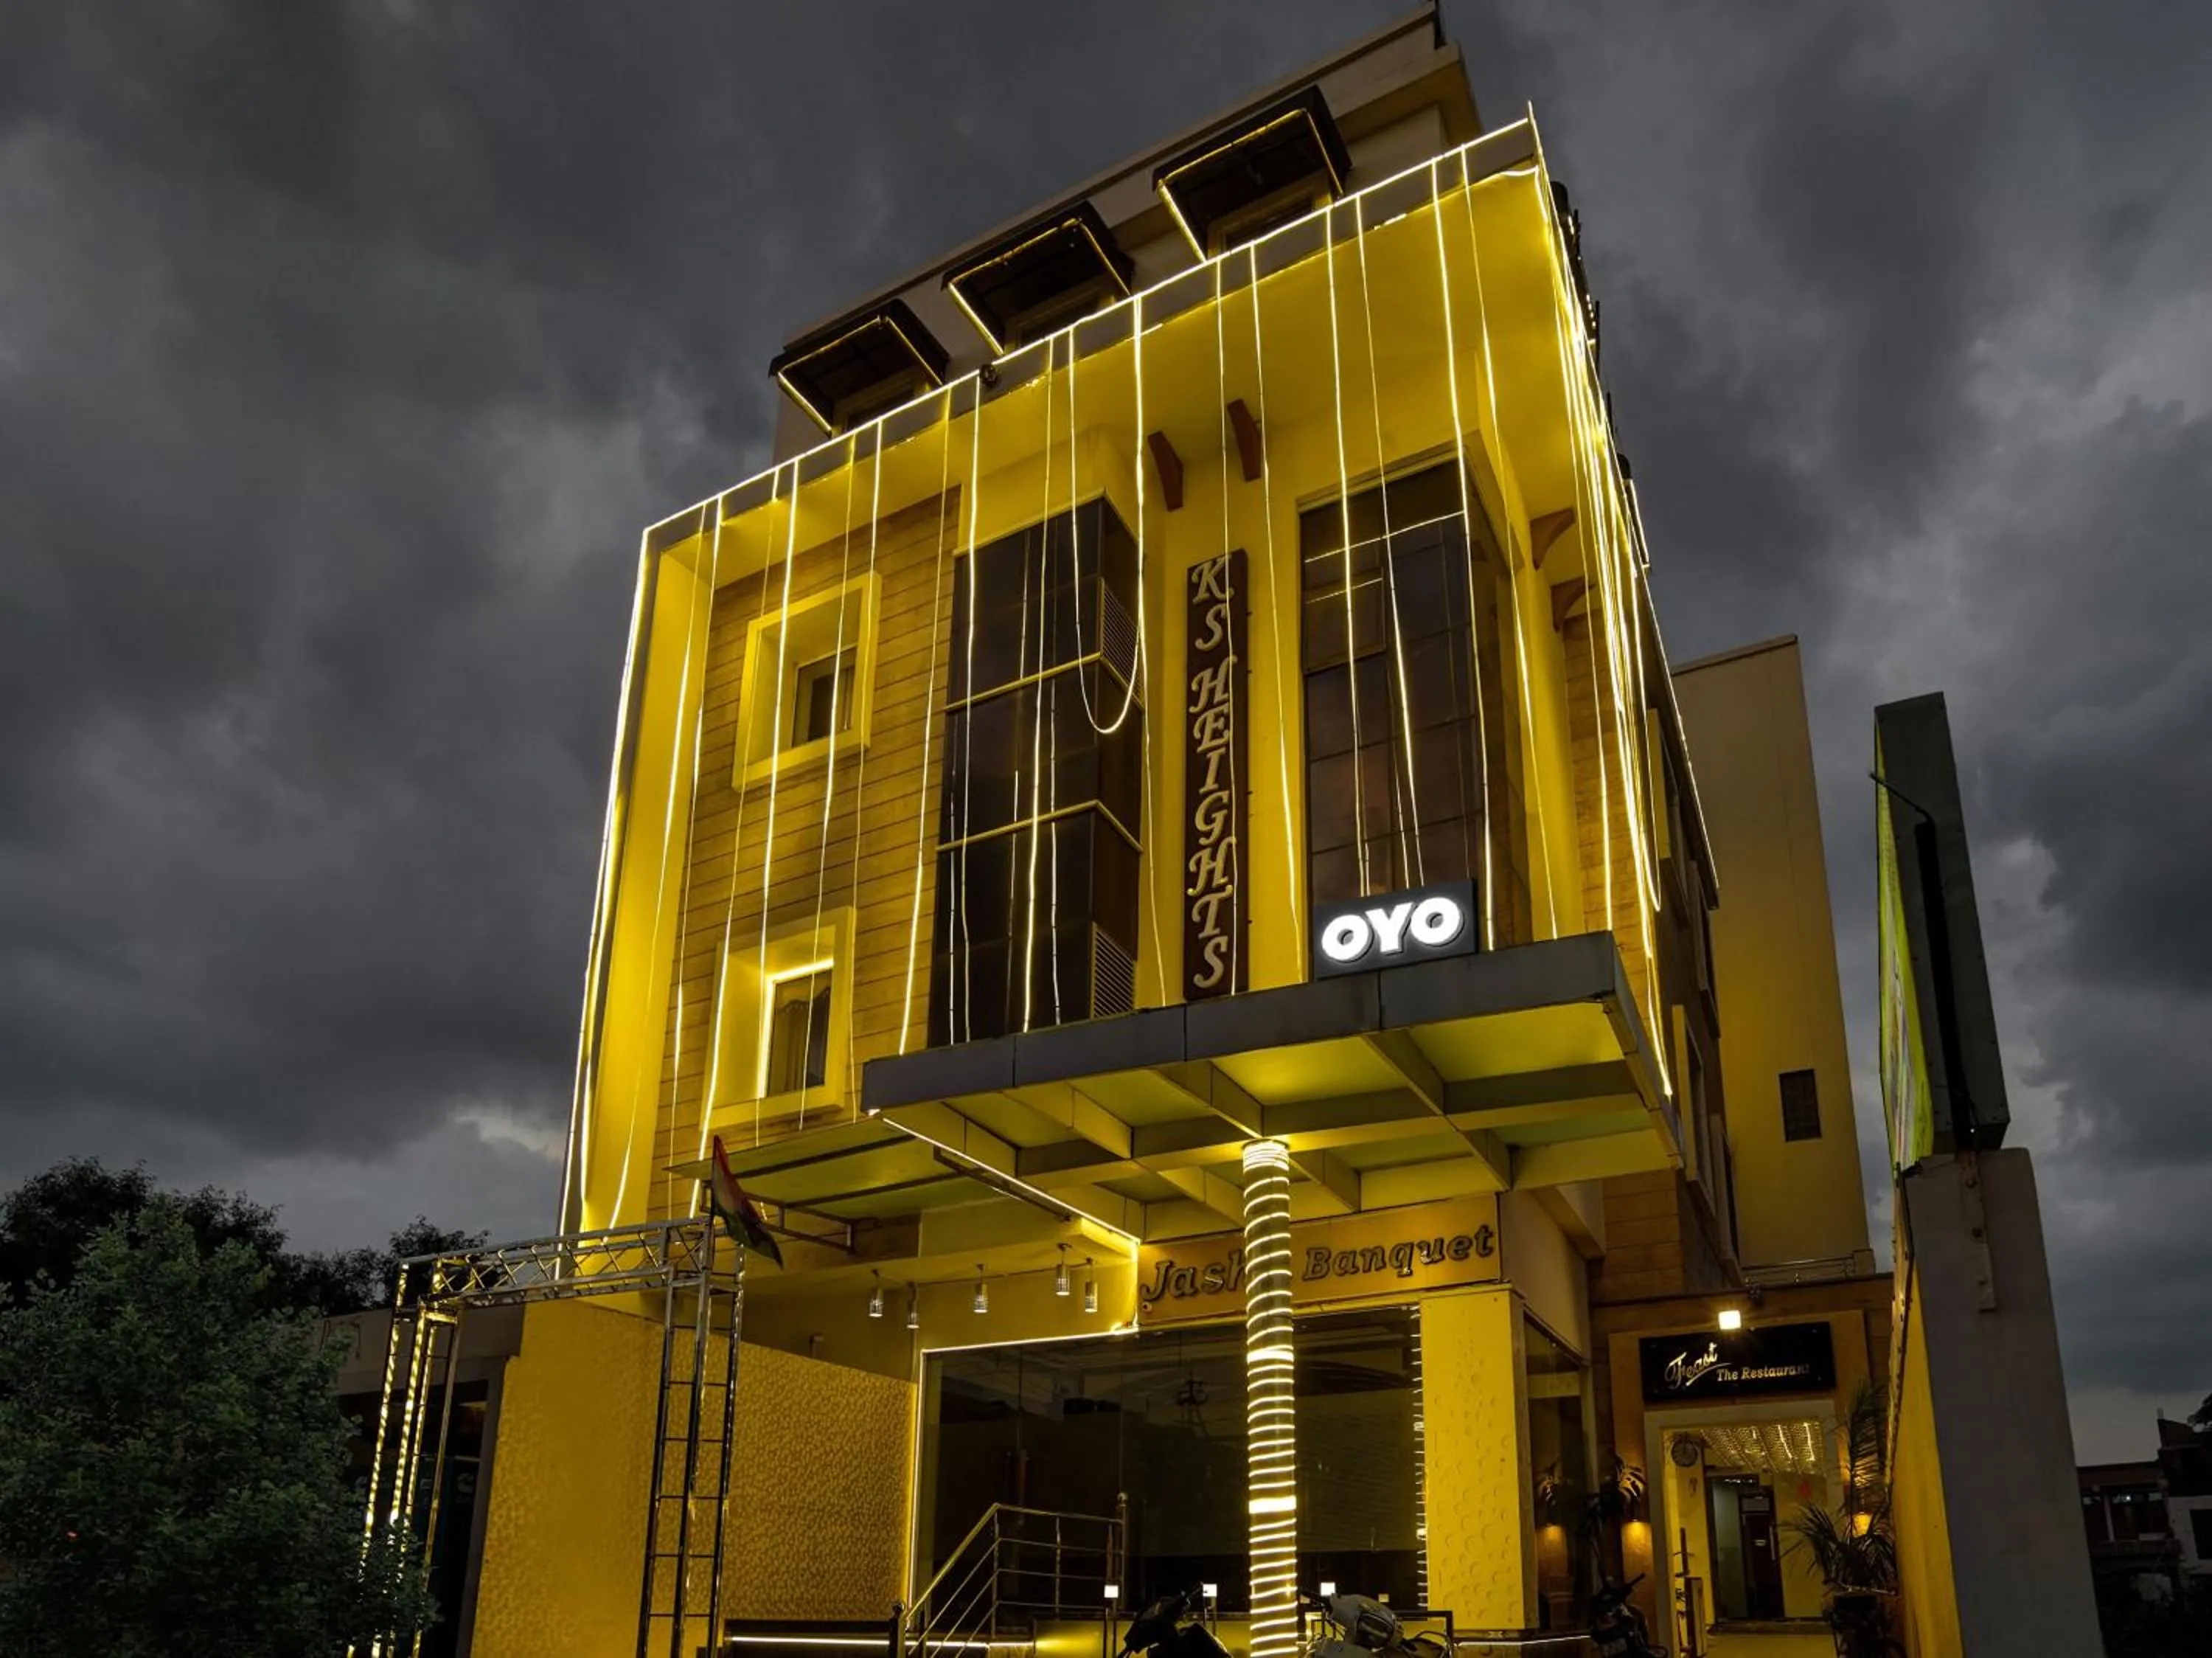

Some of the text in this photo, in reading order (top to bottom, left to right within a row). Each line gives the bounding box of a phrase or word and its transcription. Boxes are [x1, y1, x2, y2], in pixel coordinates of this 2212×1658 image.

[1187, 655, 1237, 988] HEIGHTS
[1321, 897, 1464, 963] OYO
[1303, 1224, 1495, 1280] Banquet
[1717, 1364, 1810, 1381] The Restaurant
